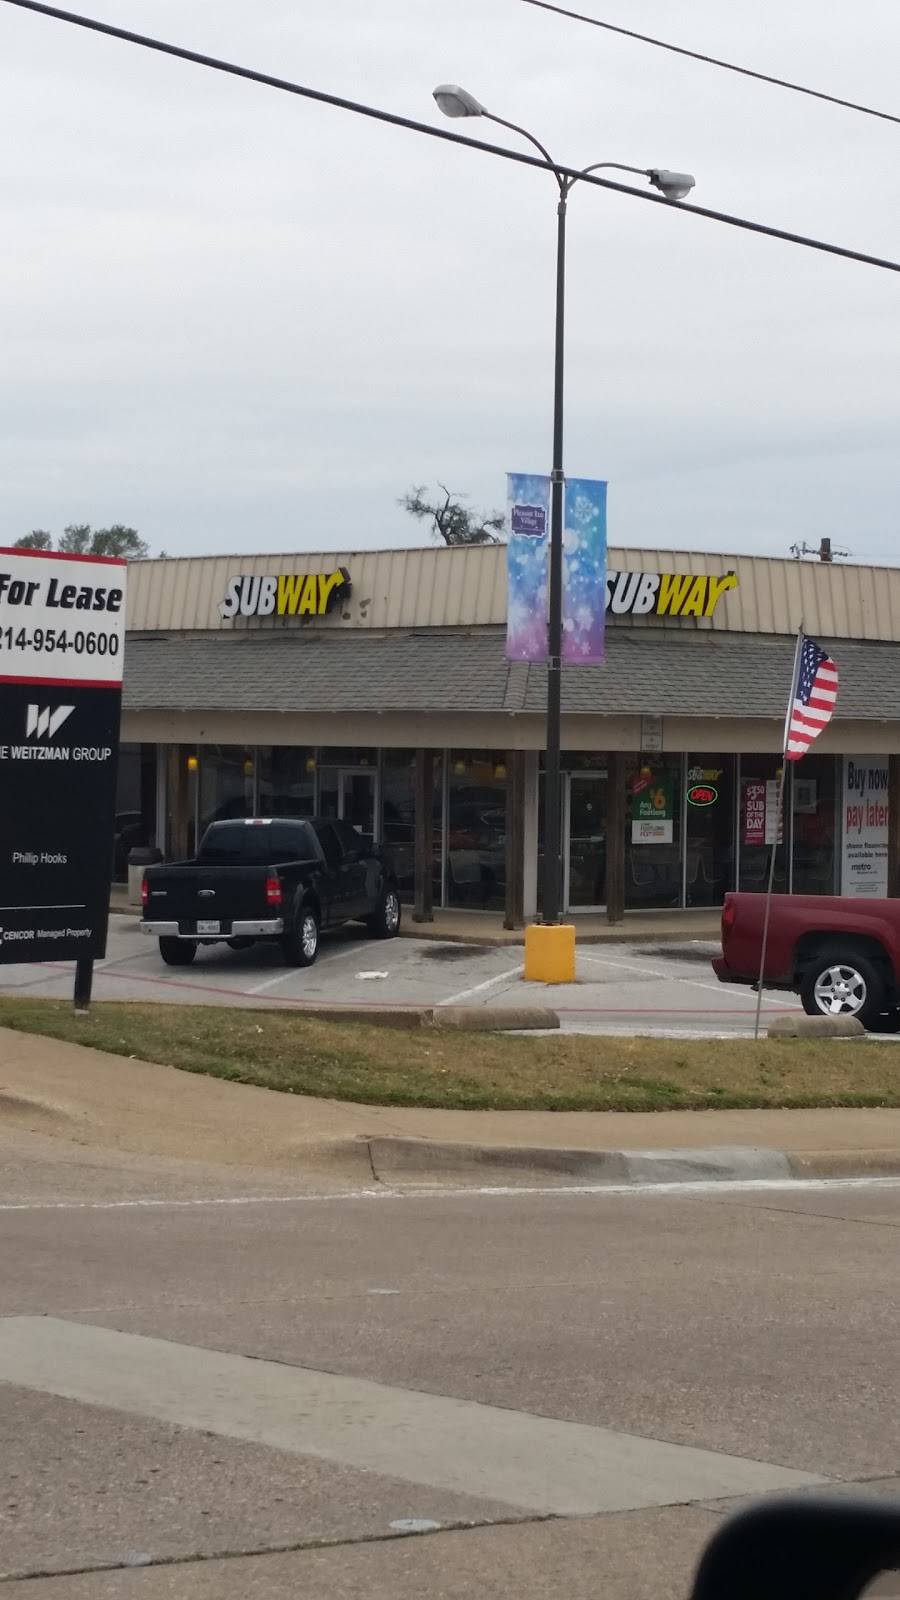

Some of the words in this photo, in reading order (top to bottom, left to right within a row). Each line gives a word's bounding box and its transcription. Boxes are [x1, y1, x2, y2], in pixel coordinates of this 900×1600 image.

[0, 573, 40, 606] For
[45, 578, 123, 612] Lease
[219, 568, 345, 618] SUBWAY
[11, 746, 70, 760] WEITZMAN
[72, 747, 112, 760] GROUP
[848, 761, 866, 797] Buy
[868, 769, 888, 790] now
[690, 788, 714, 801] OPEN
[746, 800, 765, 811] SUB
[746, 819, 764, 829] DAY
[847, 805, 863, 834] pay
[13, 852, 39, 866] Phillip
[40, 852, 68, 864] Hooks
[851, 862, 872, 871] metro
[3, 930, 35, 940] CENCOR
[37, 928, 65, 939] Managed
[66, 928, 92, 938] Property
